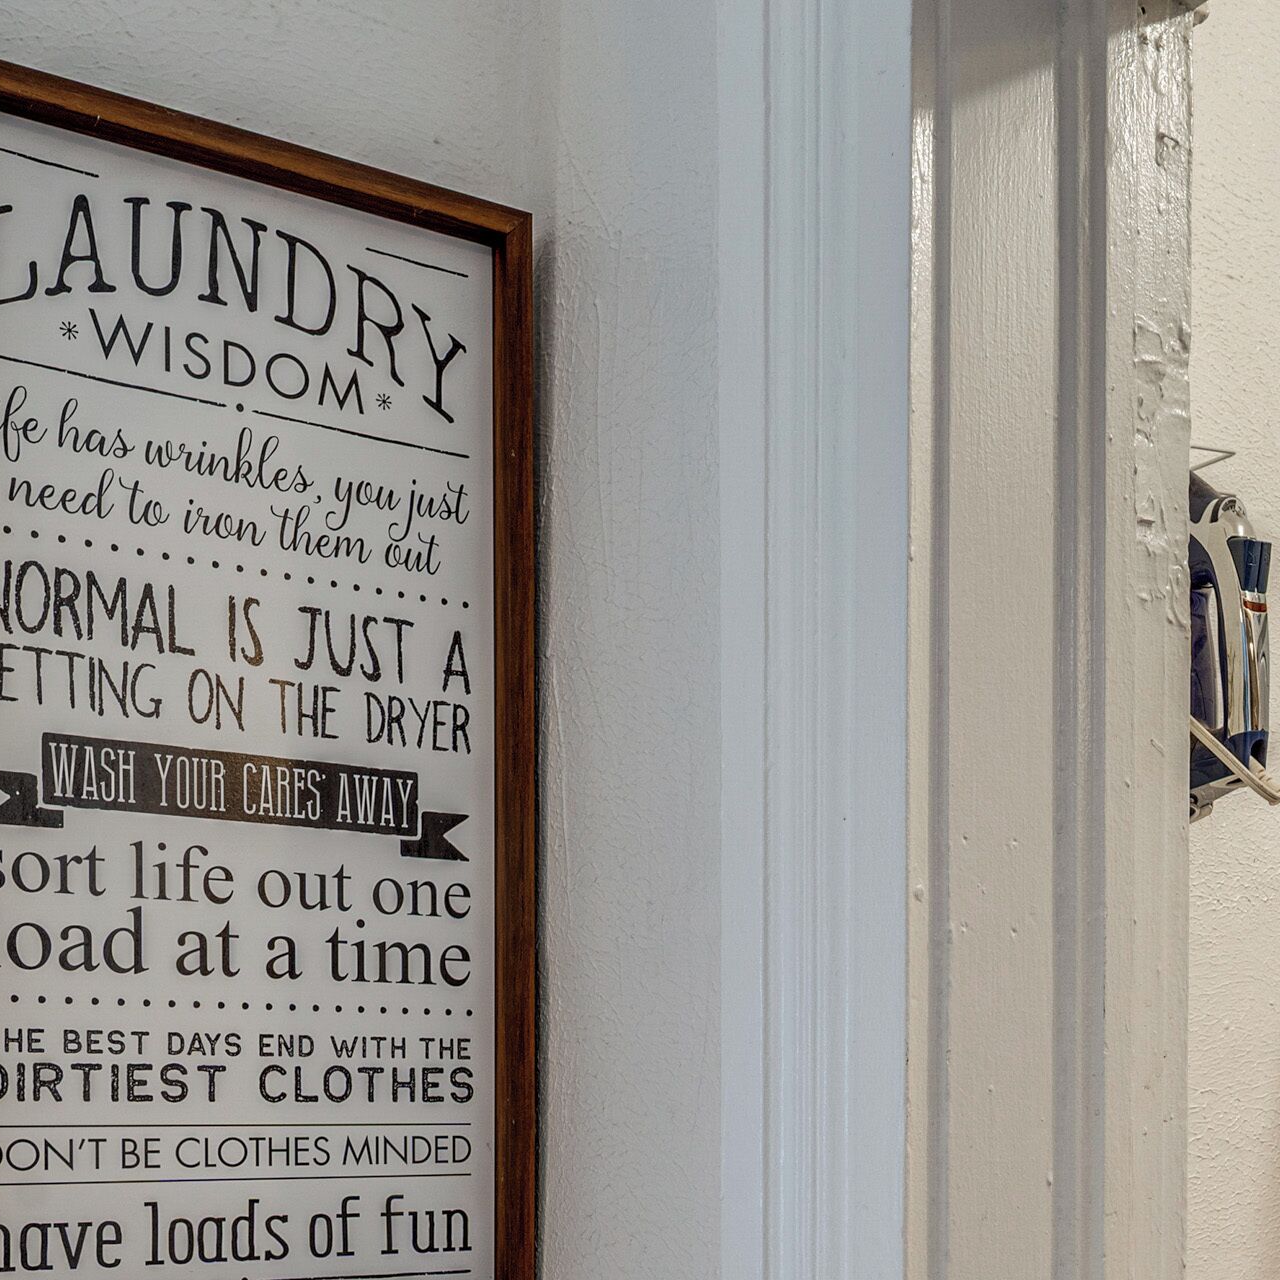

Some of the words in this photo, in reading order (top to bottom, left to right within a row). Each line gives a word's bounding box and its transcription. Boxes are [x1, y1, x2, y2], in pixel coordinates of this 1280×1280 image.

[89, 308, 364, 415] WISDOM
[58, 398, 135, 459] has
[145, 427, 321, 503] wrinkles,
[326, 476, 400, 529] you
[389, 478, 469, 542] just
[9, 469, 114, 519] need
[127, 470, 169, 526] to
[184, 500, 266, 546] iron
[271, 504, 372, 564] them
[385, 531, 441, 575] out
[227, 596, 264, 667] IS
[294, 606, 414, 684] JUST
[443, 630, 471, 695] A
[188, 668, 245, 732] ON
[269, 678, 339, 739] THE
[365, 692, 471, 754] DRYER
[49, 742, 136, 805] WASH
[154, 754, 226, 813] YOUR
[242, 762, 322, 821] CARES
[336, 772, 414, 829] AWAY
[130, 840, 234, 904] life
[257, 865, 352, 912] out
[372, 876, 471, 919] one
[176, 920, 240, 977] at
[266, 935, 303, 981] a
[326, 919, 471, 987] time
[64, 1029, 149, 1056] BEST
[167, 1032, 242, 1057] DAYS
[259, 1034, 315, 1057] END
[331, 1035, 406, 1060] WITH
[420, 1037, 471, 1060] THE
[259, 1064, 474, 1103] CLOTHES
[121, 1138, 161, 1170] BE
[175, 1136, 330, 1169] CLOTHES
[342, 1134, 471, 1168] MINDED
[144, 1199, 289, 1266] loads
[309, 1196, 360, 1258] of
[380, 1194, 472, 1257] fun
